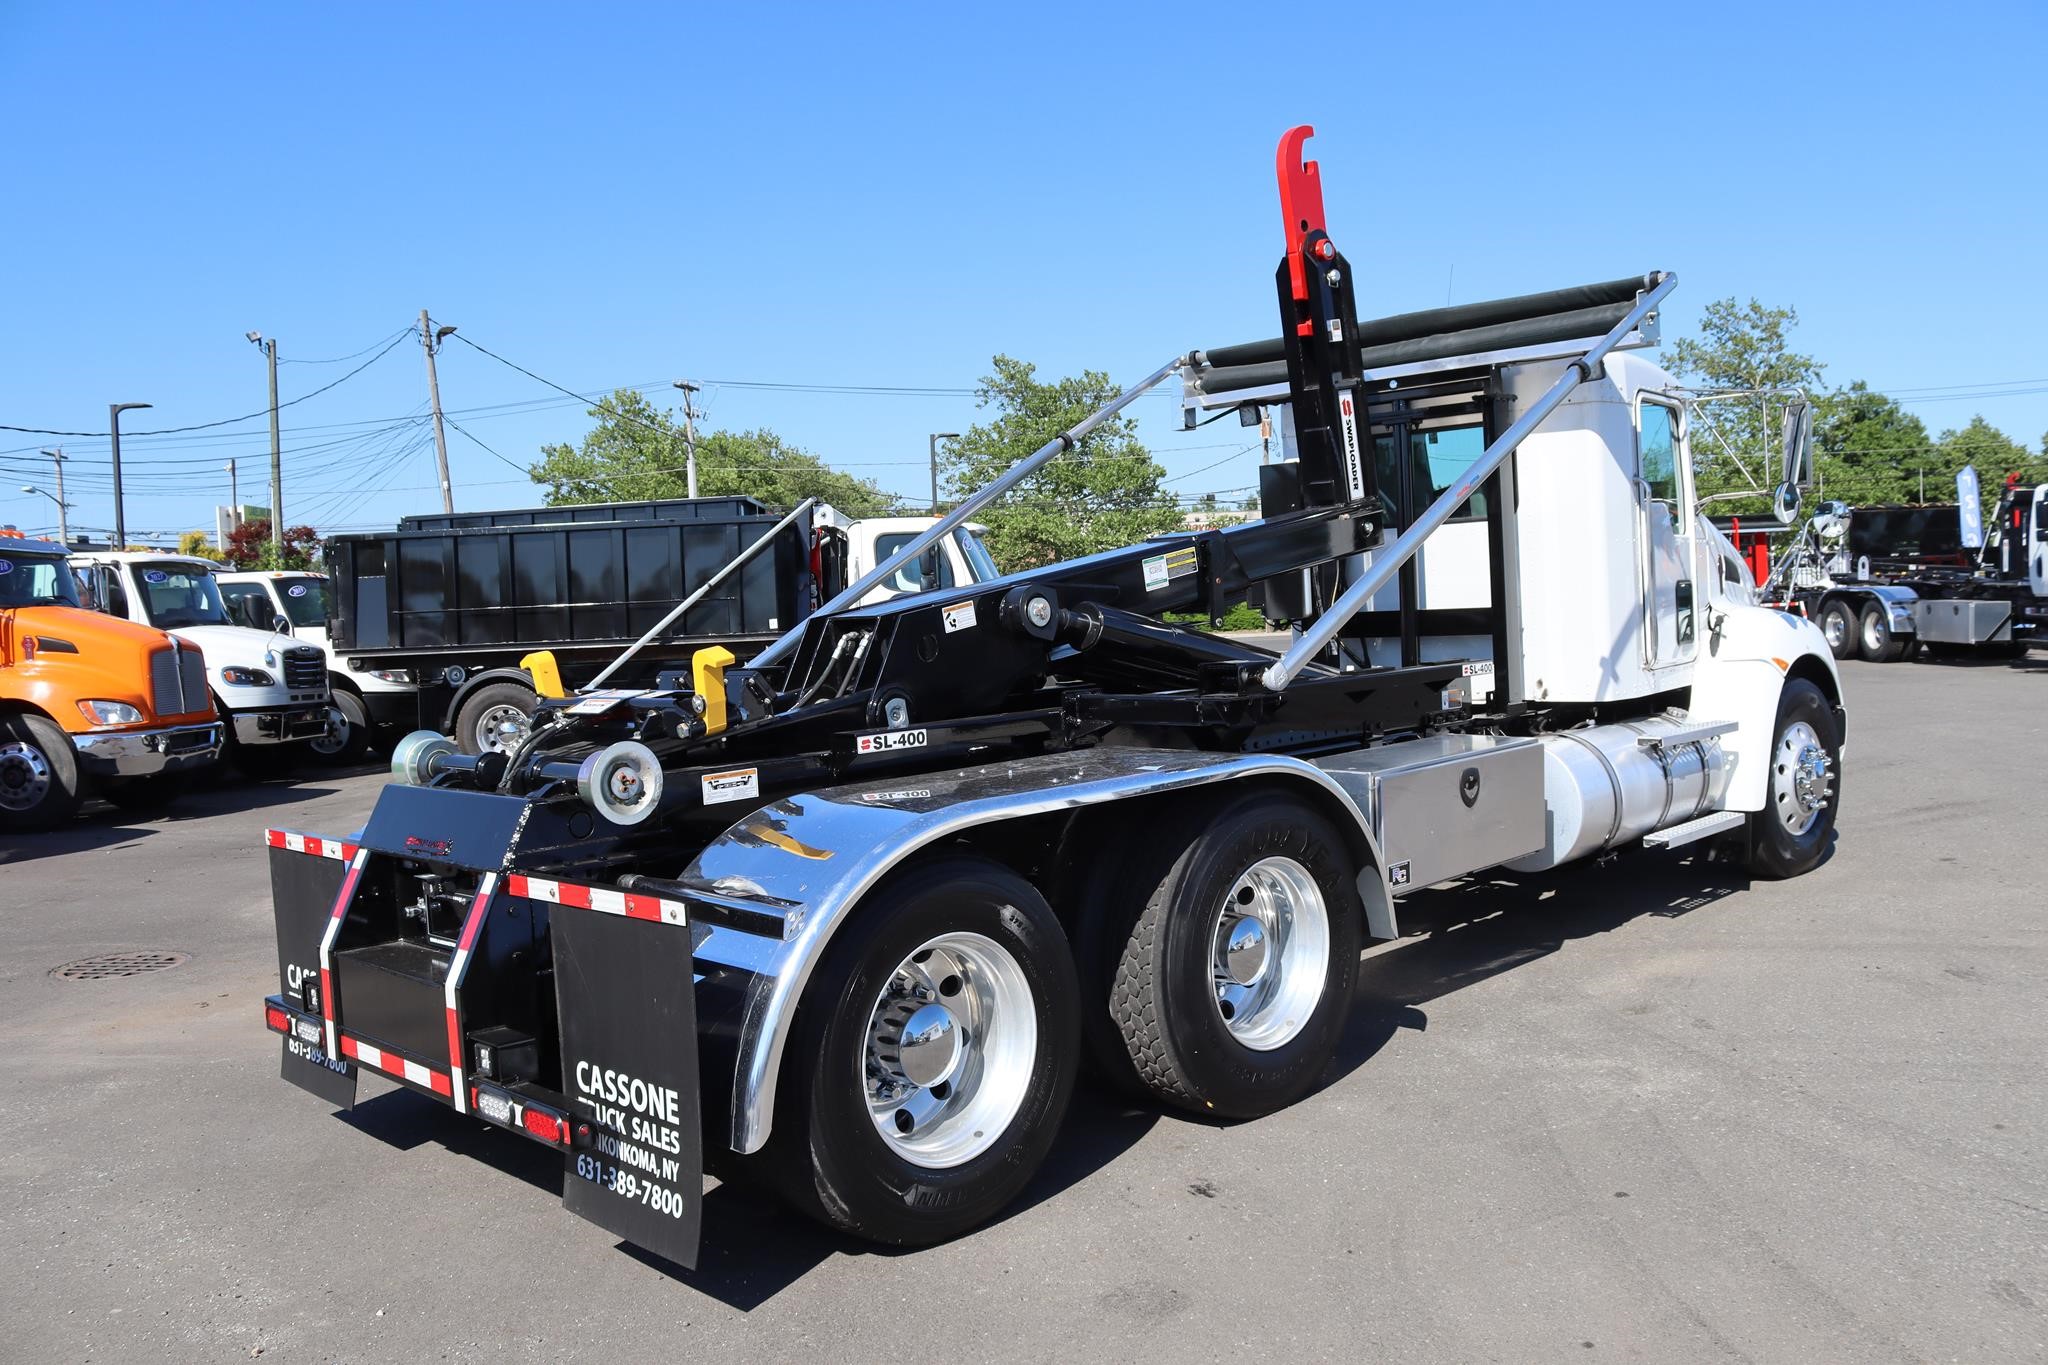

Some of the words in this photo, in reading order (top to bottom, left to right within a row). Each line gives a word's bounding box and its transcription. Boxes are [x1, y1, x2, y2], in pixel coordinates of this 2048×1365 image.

[1345, 419, 1359, 490] SWAPLOADER
[1469, 663, 1493, 674] SL-400
[872, 731, 925, 750] SL-400
[576, 1060, 680, 1126] CASSONE
[578, 1096, 627, 1135] UCK
[631, 1117, 680, 1155] SALES
[577, 1154, 683, 1219] 631-389-7800
[662, 1157, 680, 1183] NY
